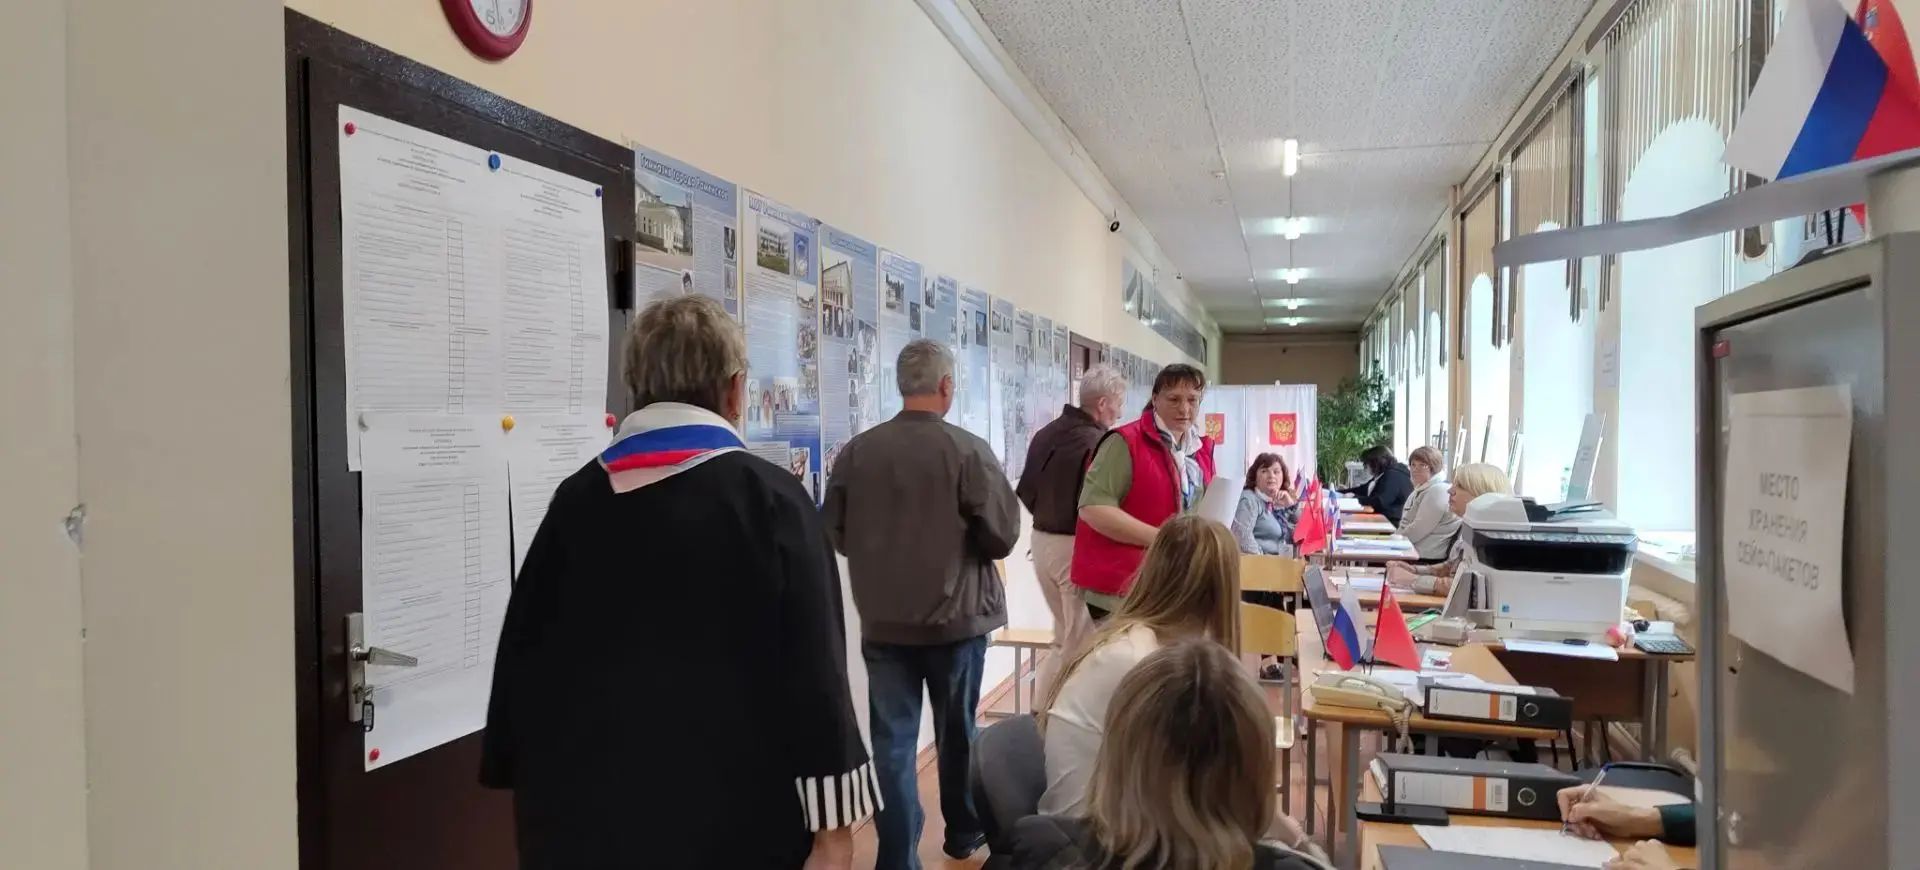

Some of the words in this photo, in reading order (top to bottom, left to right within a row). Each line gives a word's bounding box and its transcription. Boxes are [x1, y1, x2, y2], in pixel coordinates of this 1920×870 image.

[1760, 471, 1799, 501] МЕСТО
[1748, 508, 1807, 542] ХРАНЕНИЯ
[1738, 539, 1819, 590] СЕЙФ-ПАКЕТОВ
